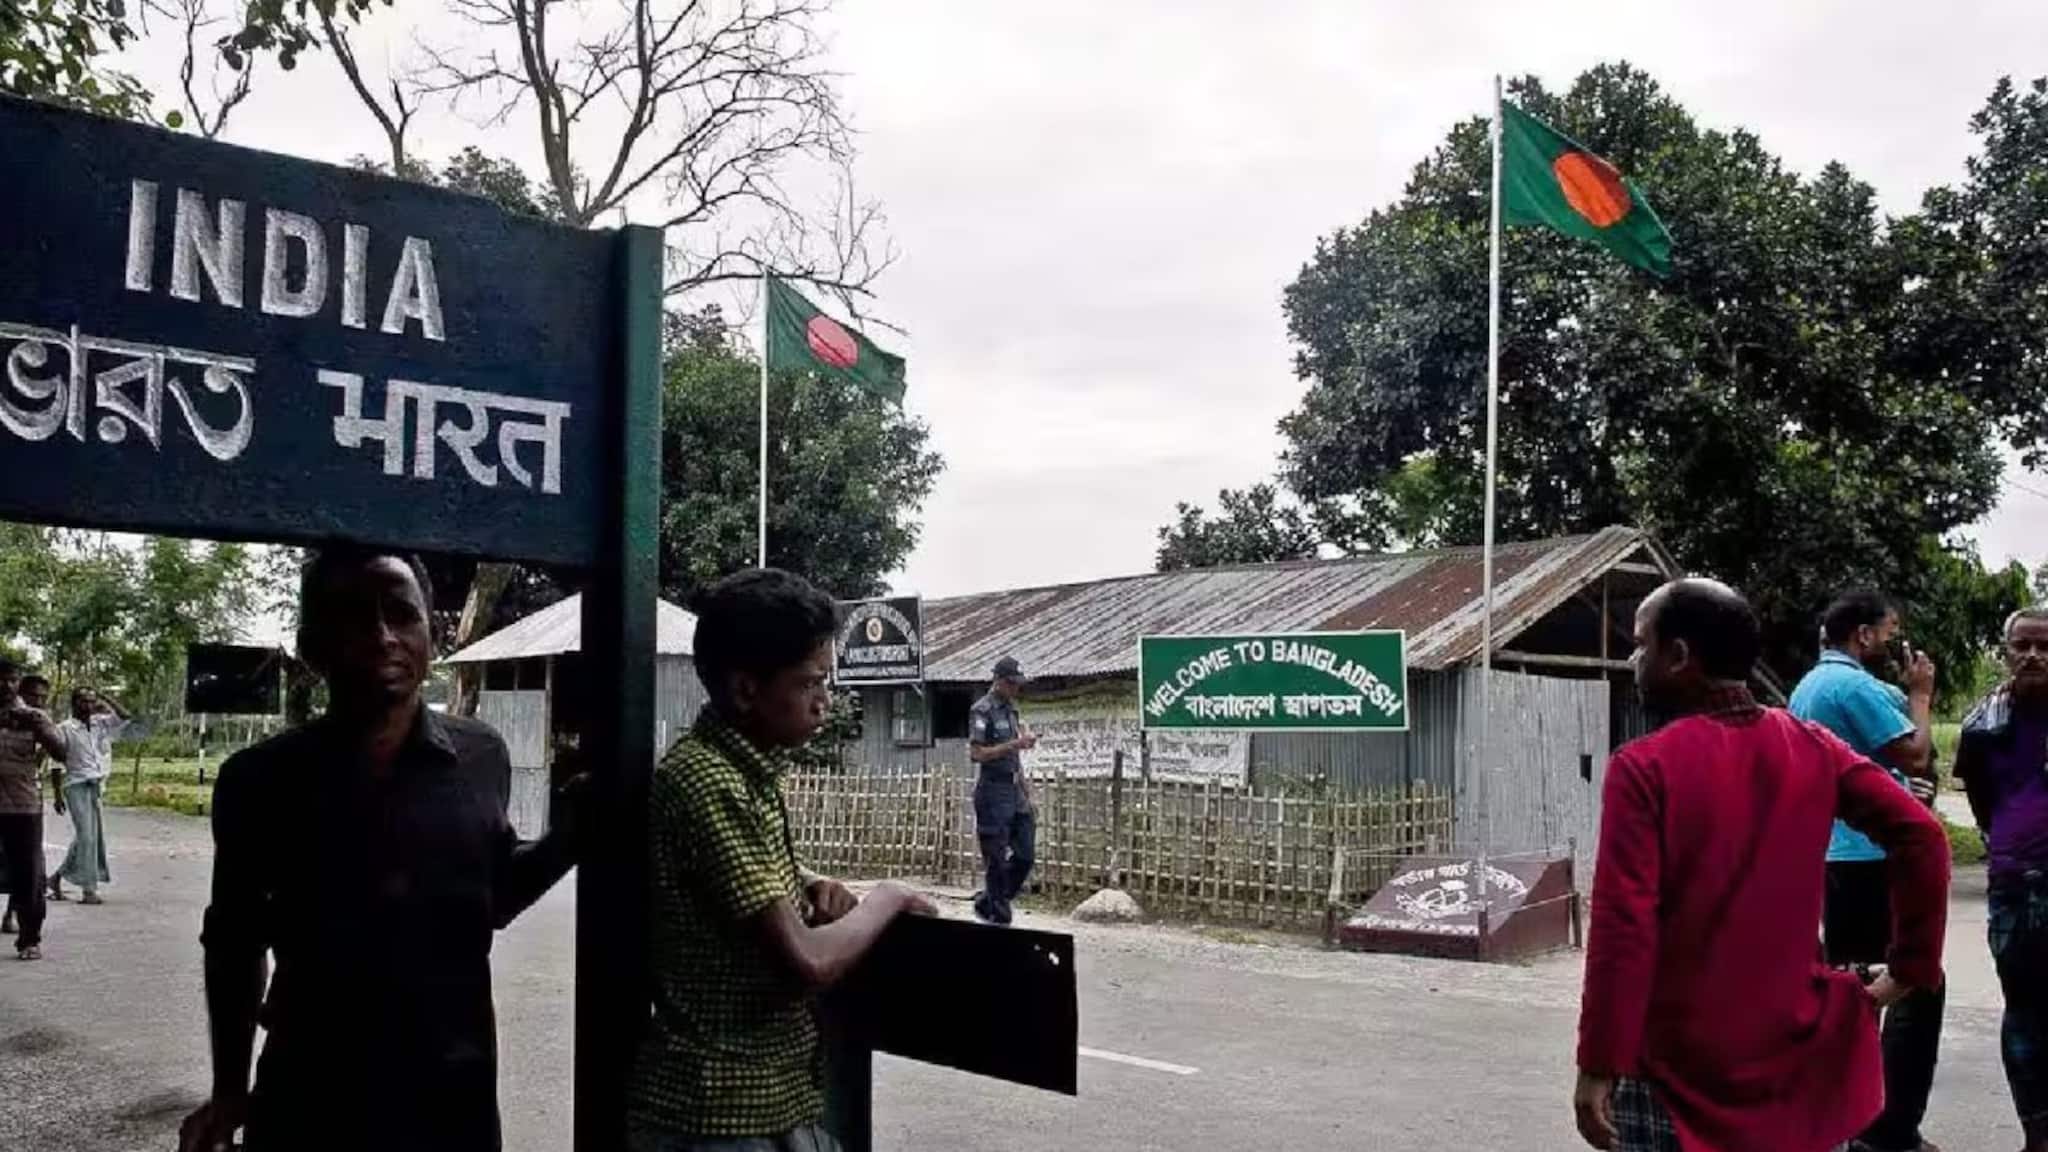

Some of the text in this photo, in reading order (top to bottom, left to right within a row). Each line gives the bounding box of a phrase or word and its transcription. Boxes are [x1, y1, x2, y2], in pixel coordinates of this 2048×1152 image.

[125, 179, 446, 341] INDIA
[0, 321, 256, 461] ভারত
[317, 370, 572, 495] भारत
[1145, 639, 1402, 718] WELCOME TO BANGLADESH
[1183, 693, 1363, 720] বাংলাদেশে স্বাগতম
